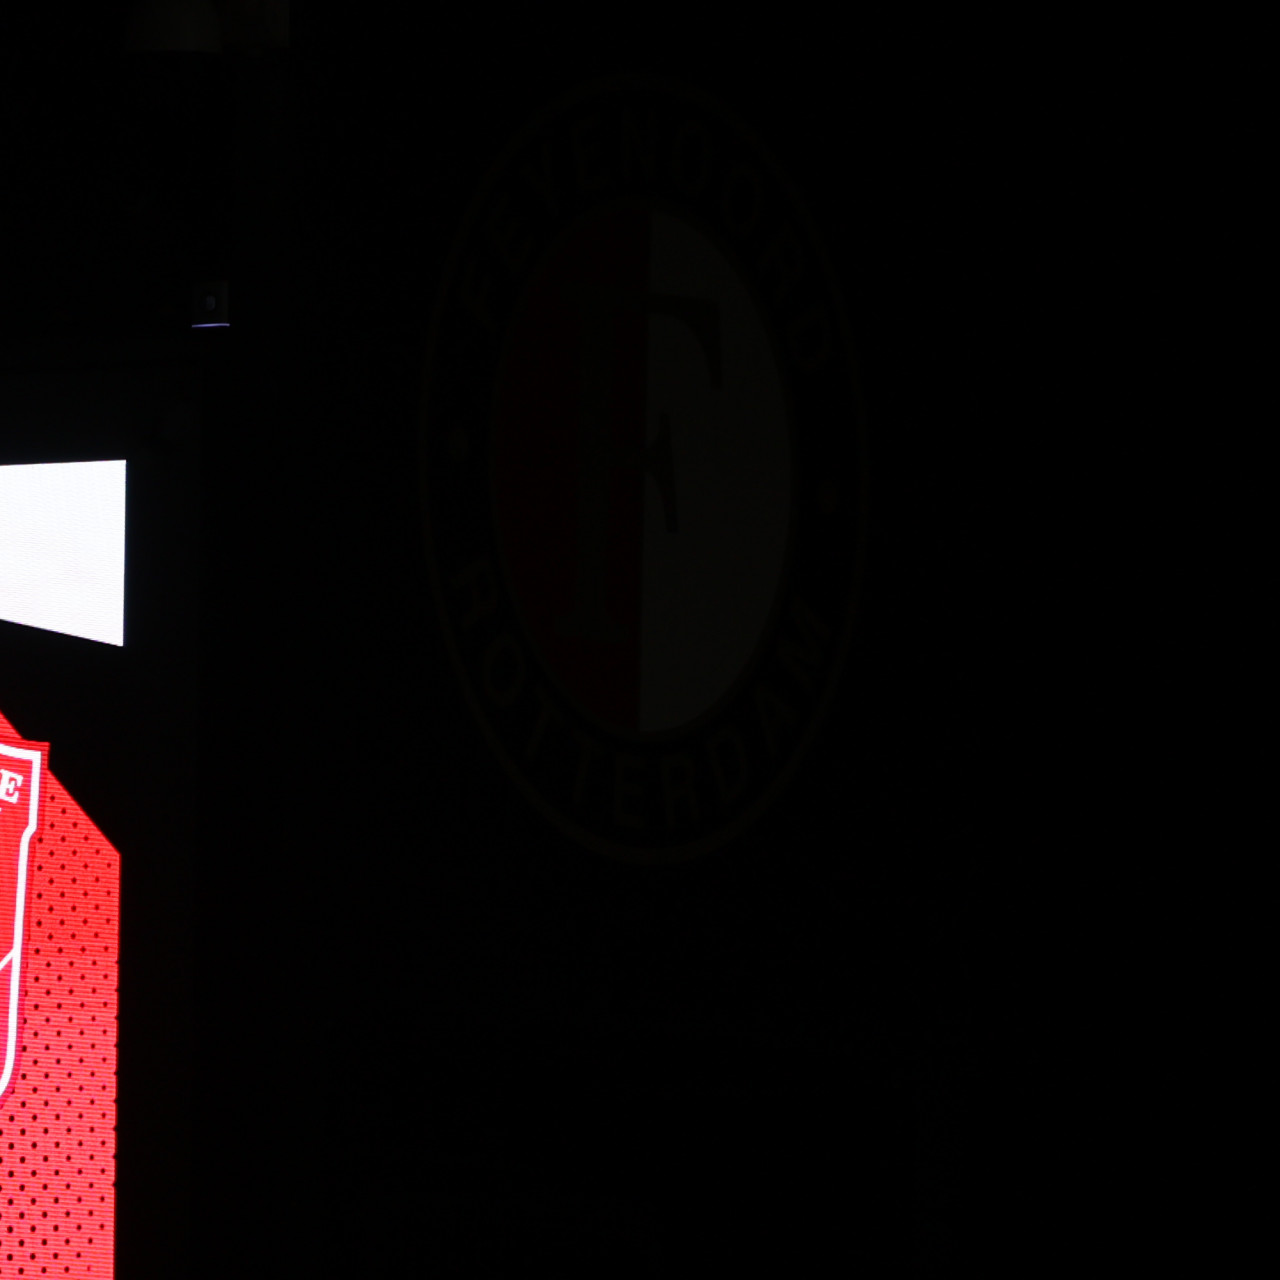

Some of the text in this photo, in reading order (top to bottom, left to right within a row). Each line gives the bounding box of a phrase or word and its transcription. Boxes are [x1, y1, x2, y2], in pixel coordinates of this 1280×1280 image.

[454, 104, 835, 378] FEYENOORD
[553, 279, 725, 645] F
[450, 554, 836, 835] ROTTERDAM
